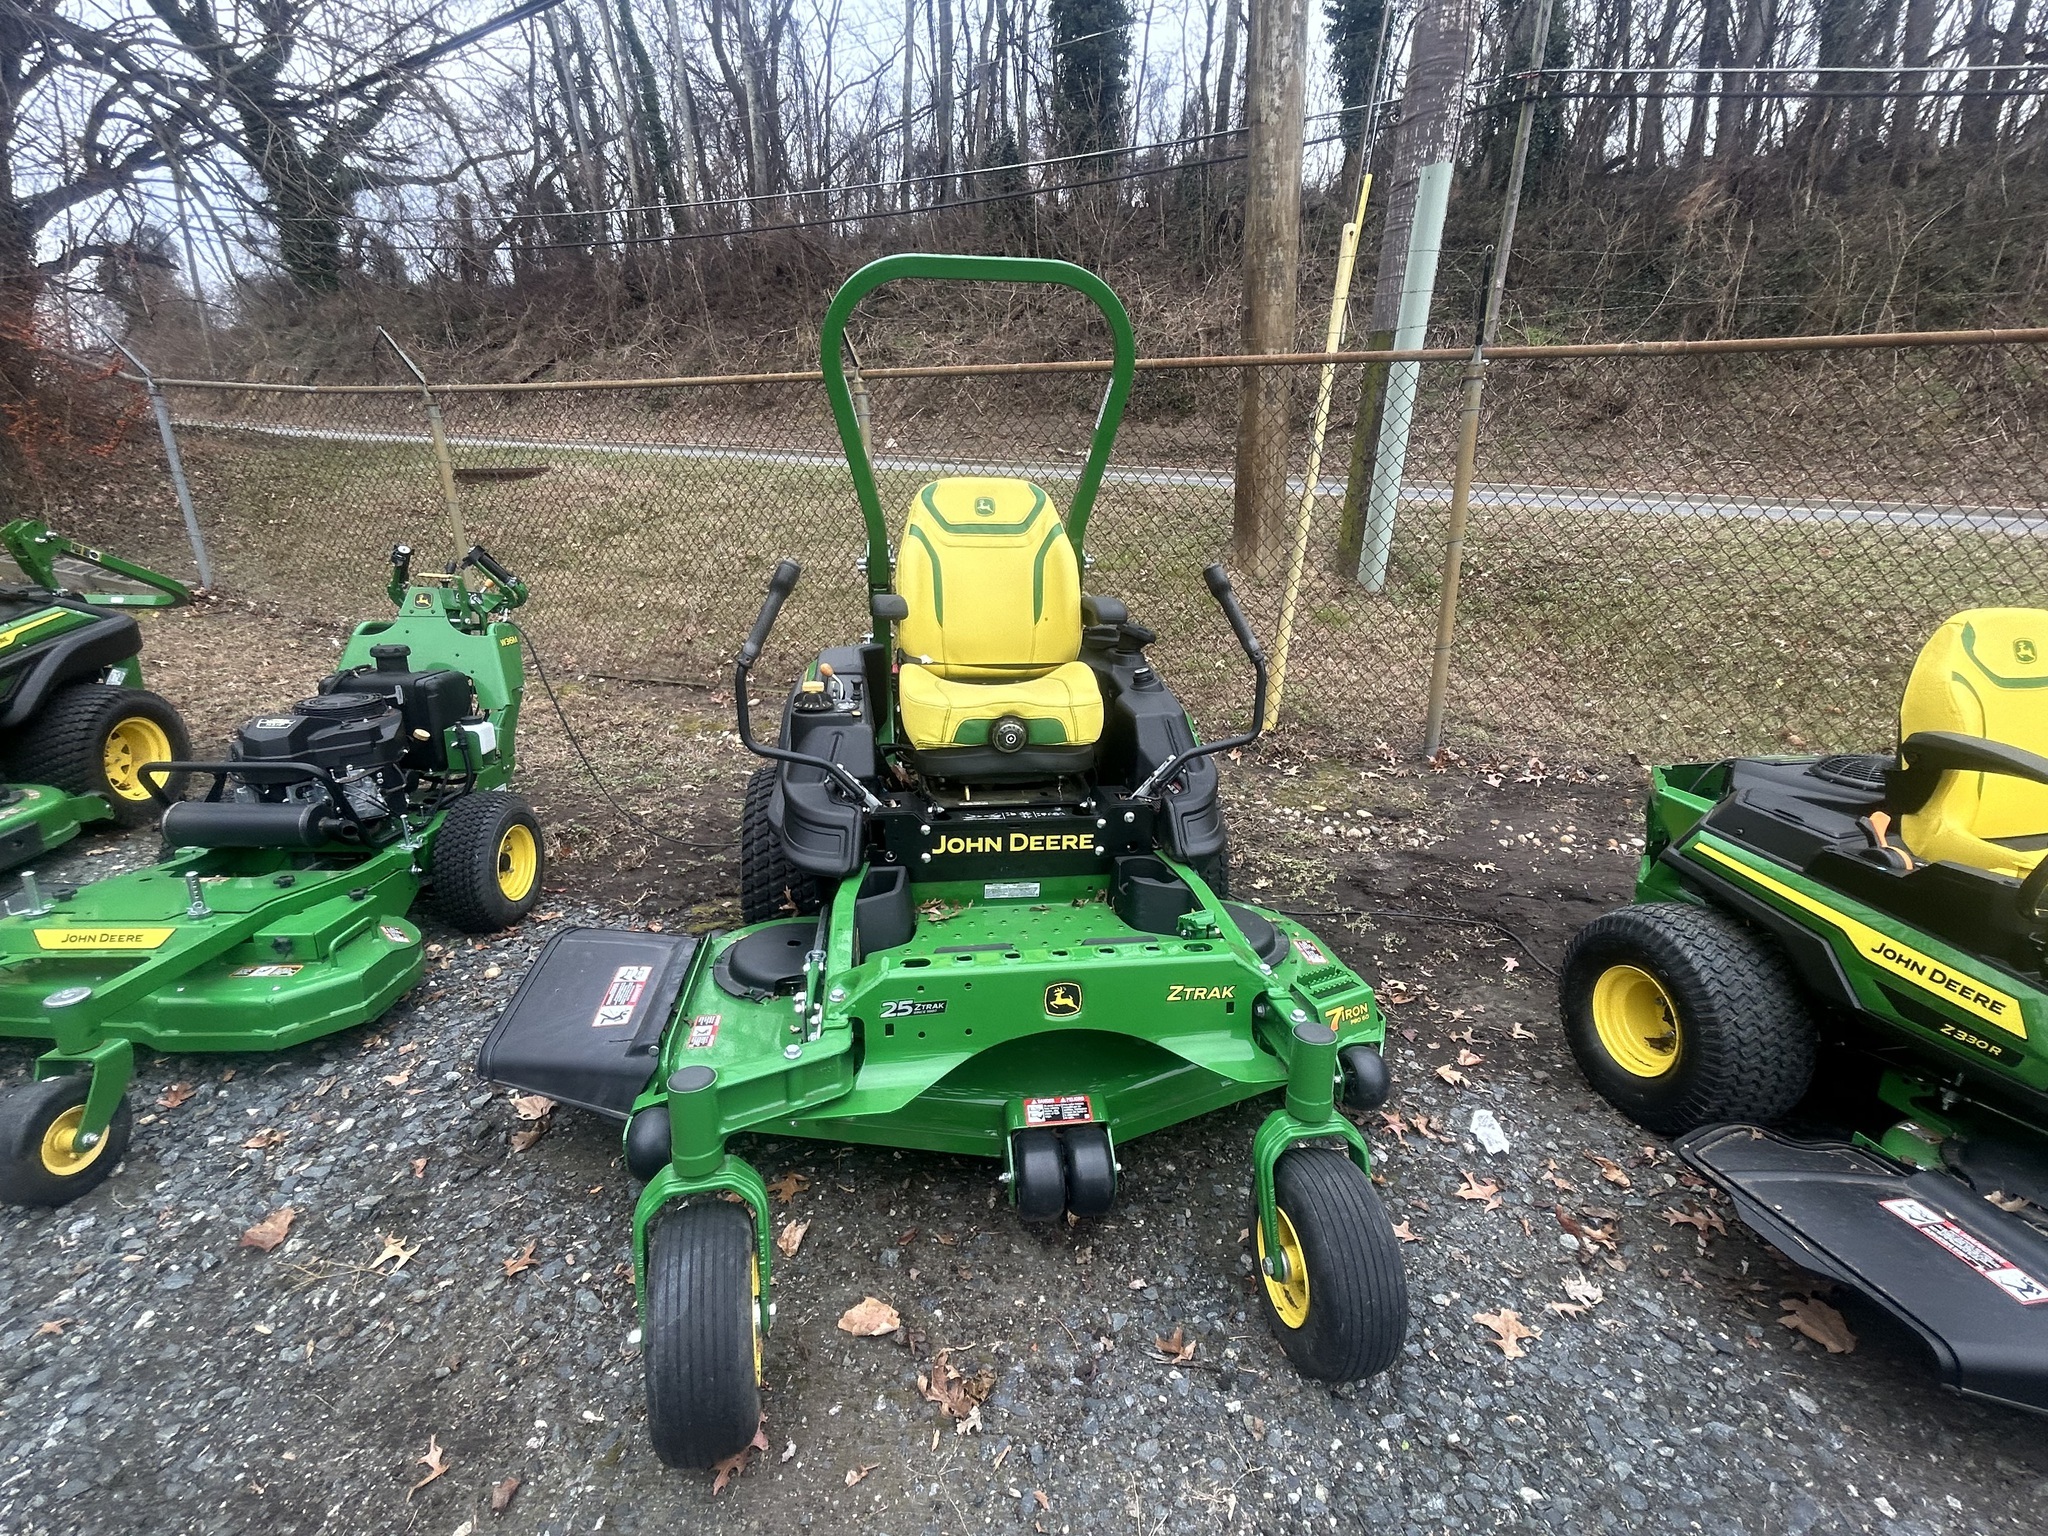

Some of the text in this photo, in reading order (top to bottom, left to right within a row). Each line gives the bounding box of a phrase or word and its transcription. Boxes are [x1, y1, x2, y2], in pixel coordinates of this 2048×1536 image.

[932, 832, 1095, 855] JOHN DEERE
[61, 933, 144, 943] JOHN DEERE
[1870, 942, 2007, 1015] JOHN DEERE
[1166, 985, 1236, 1001] ZTRAK
[880, 1000, 945, 1018] 25 ZTRAK
